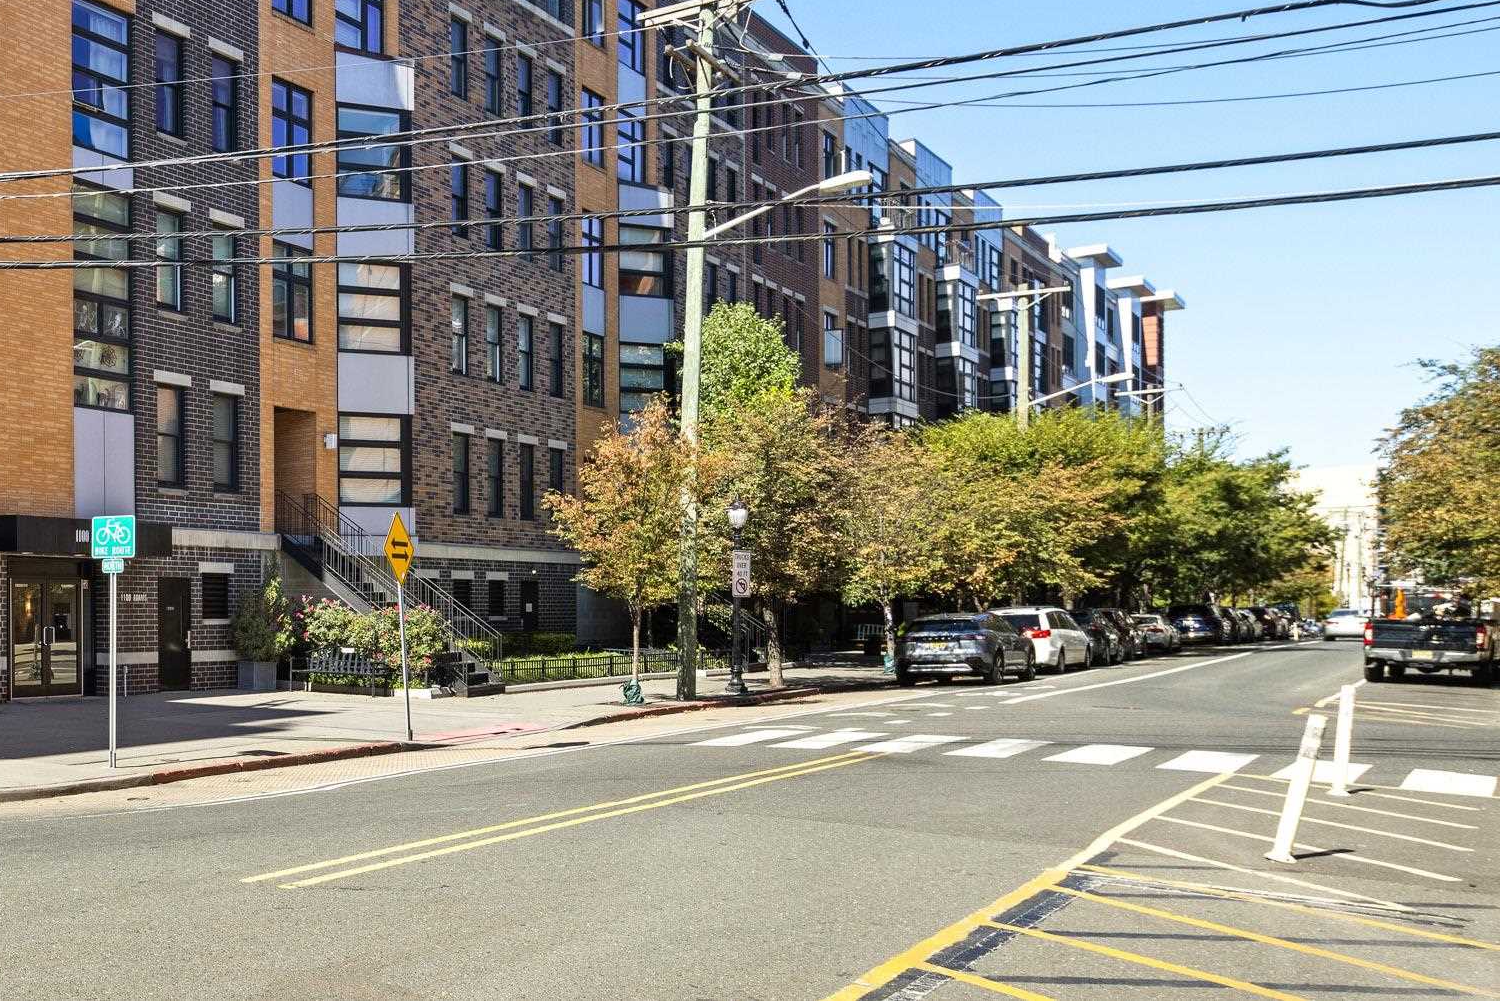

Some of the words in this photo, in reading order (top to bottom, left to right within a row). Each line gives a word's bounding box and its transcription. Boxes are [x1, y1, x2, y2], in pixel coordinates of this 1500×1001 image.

[76, 529, 89, 542] 1100
[95, 547, 109, 555] BIKE
[112, 546, 131, 555] ROUTE
